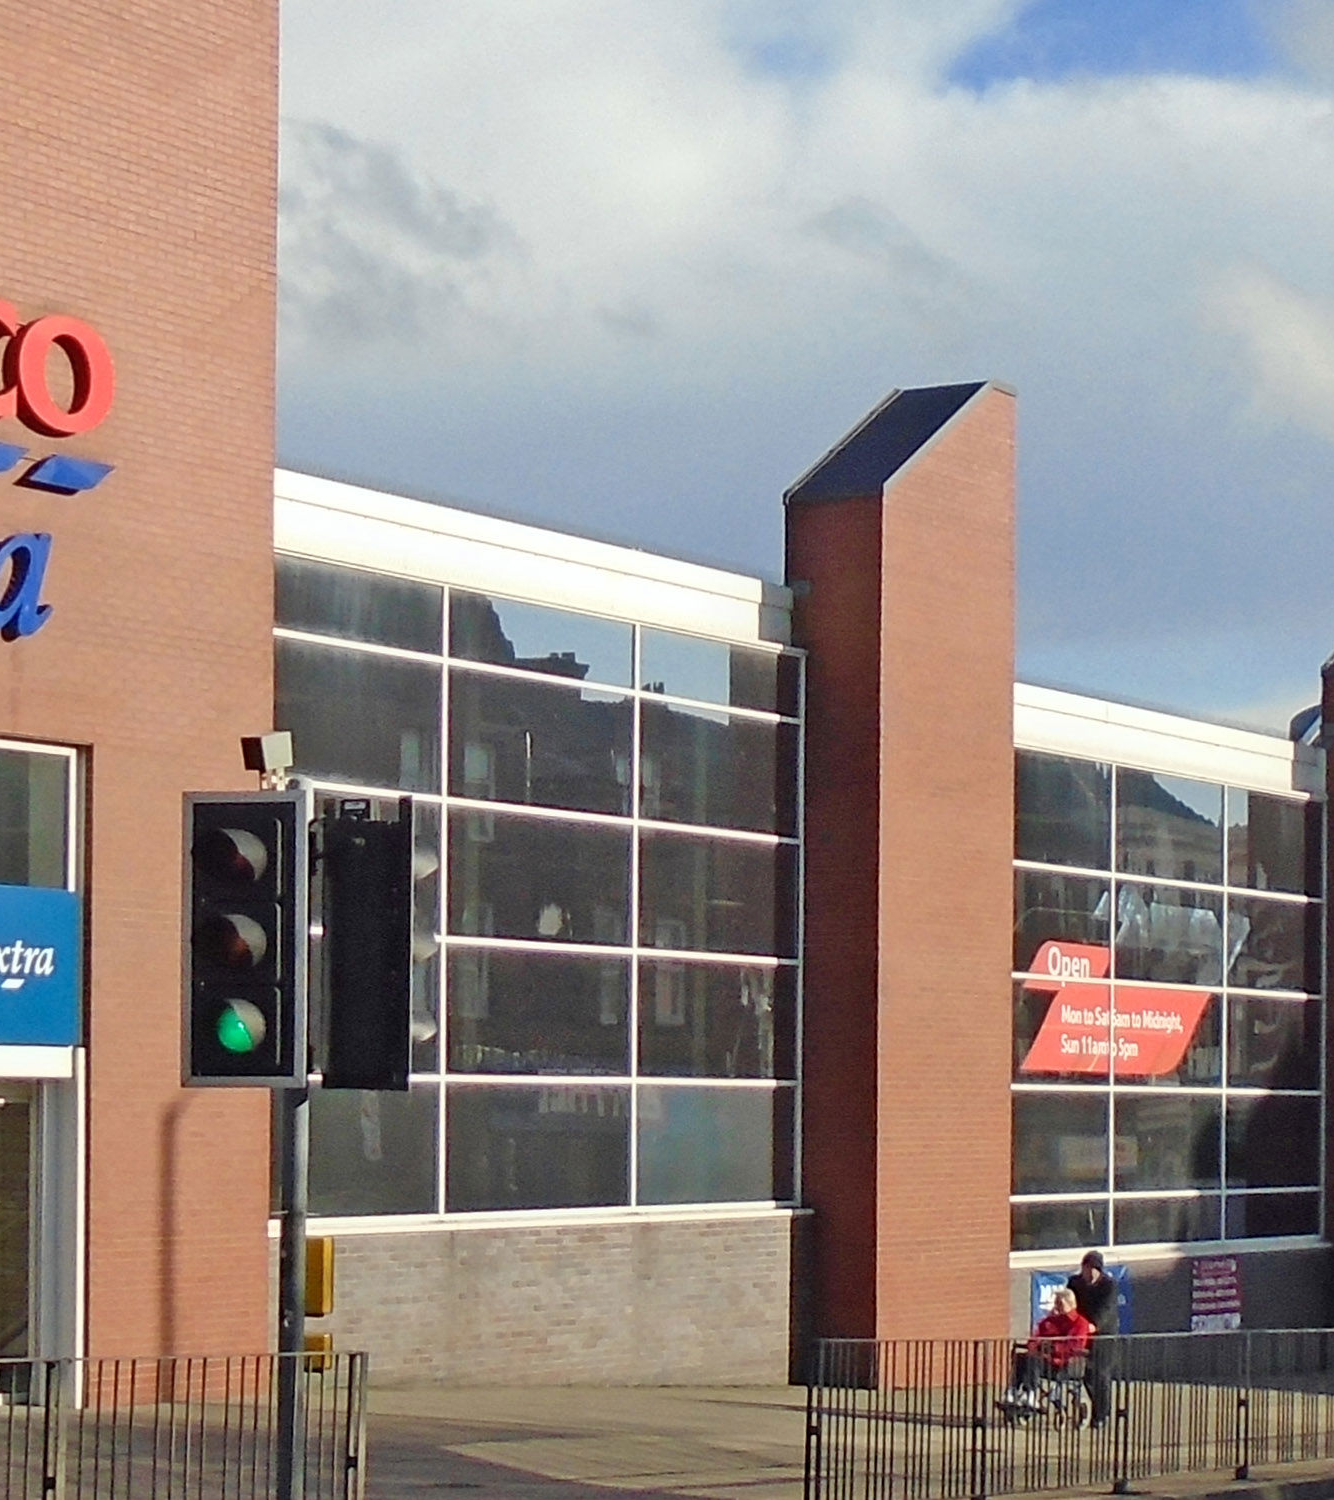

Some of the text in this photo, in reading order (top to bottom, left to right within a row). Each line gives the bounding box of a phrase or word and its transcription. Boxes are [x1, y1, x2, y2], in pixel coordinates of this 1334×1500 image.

[1047, 946, 1091, 987] Open
[1060, 1004, 1083, 1024] Mon
[1084, 1008, 1094, 1025] to
[1131, 1012, 1142, 1029] to
[1142, 1009, 1184, 1034] Midnight,
[1060, 1034, 1080, 1055] Sun
[1118, 1038, 1139, 1060] 5pm
